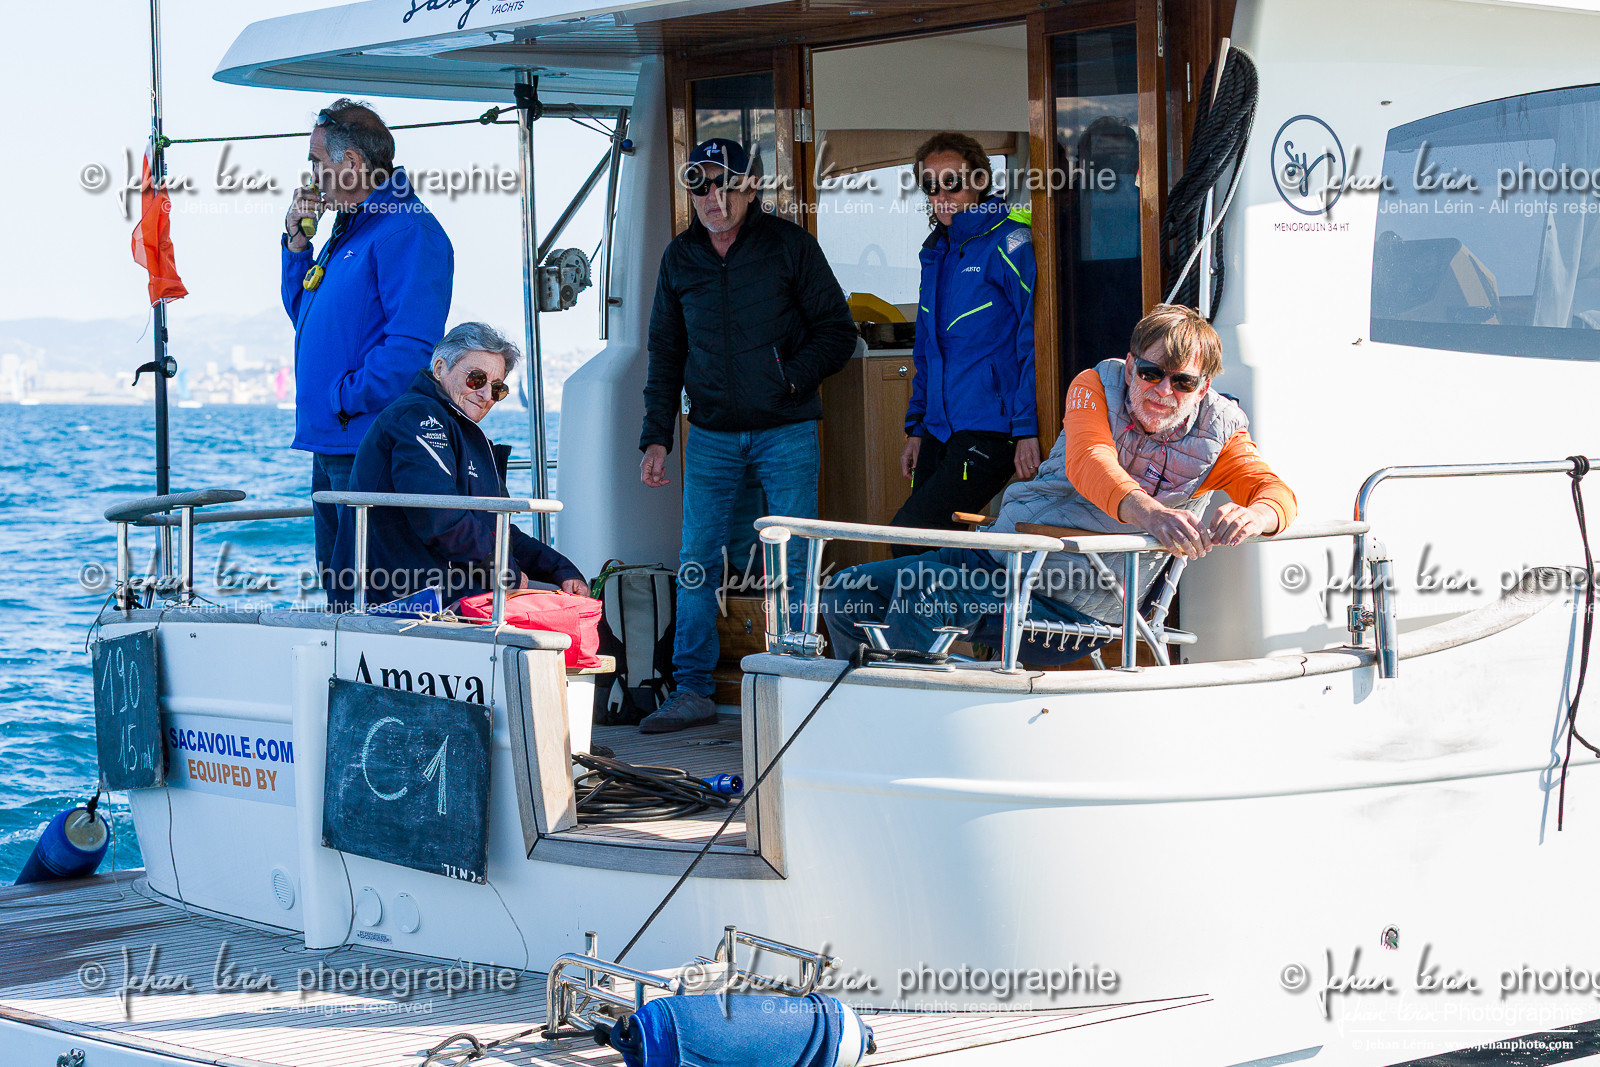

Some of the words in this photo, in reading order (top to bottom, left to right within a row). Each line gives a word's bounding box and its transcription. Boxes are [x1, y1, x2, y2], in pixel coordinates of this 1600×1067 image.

[491, 1, 525, 15] YACHTS
[1274, 222, 1326, 231] MENORQUIN
[1328, 223, 1338, 231] 34
[1340, 223, 1350, 231] HT
[169, 727, 295, 764] SACAVOILE.COM
[188, 758, 252, 788] EQUIPED
[256, 768, 278, 791] BY
